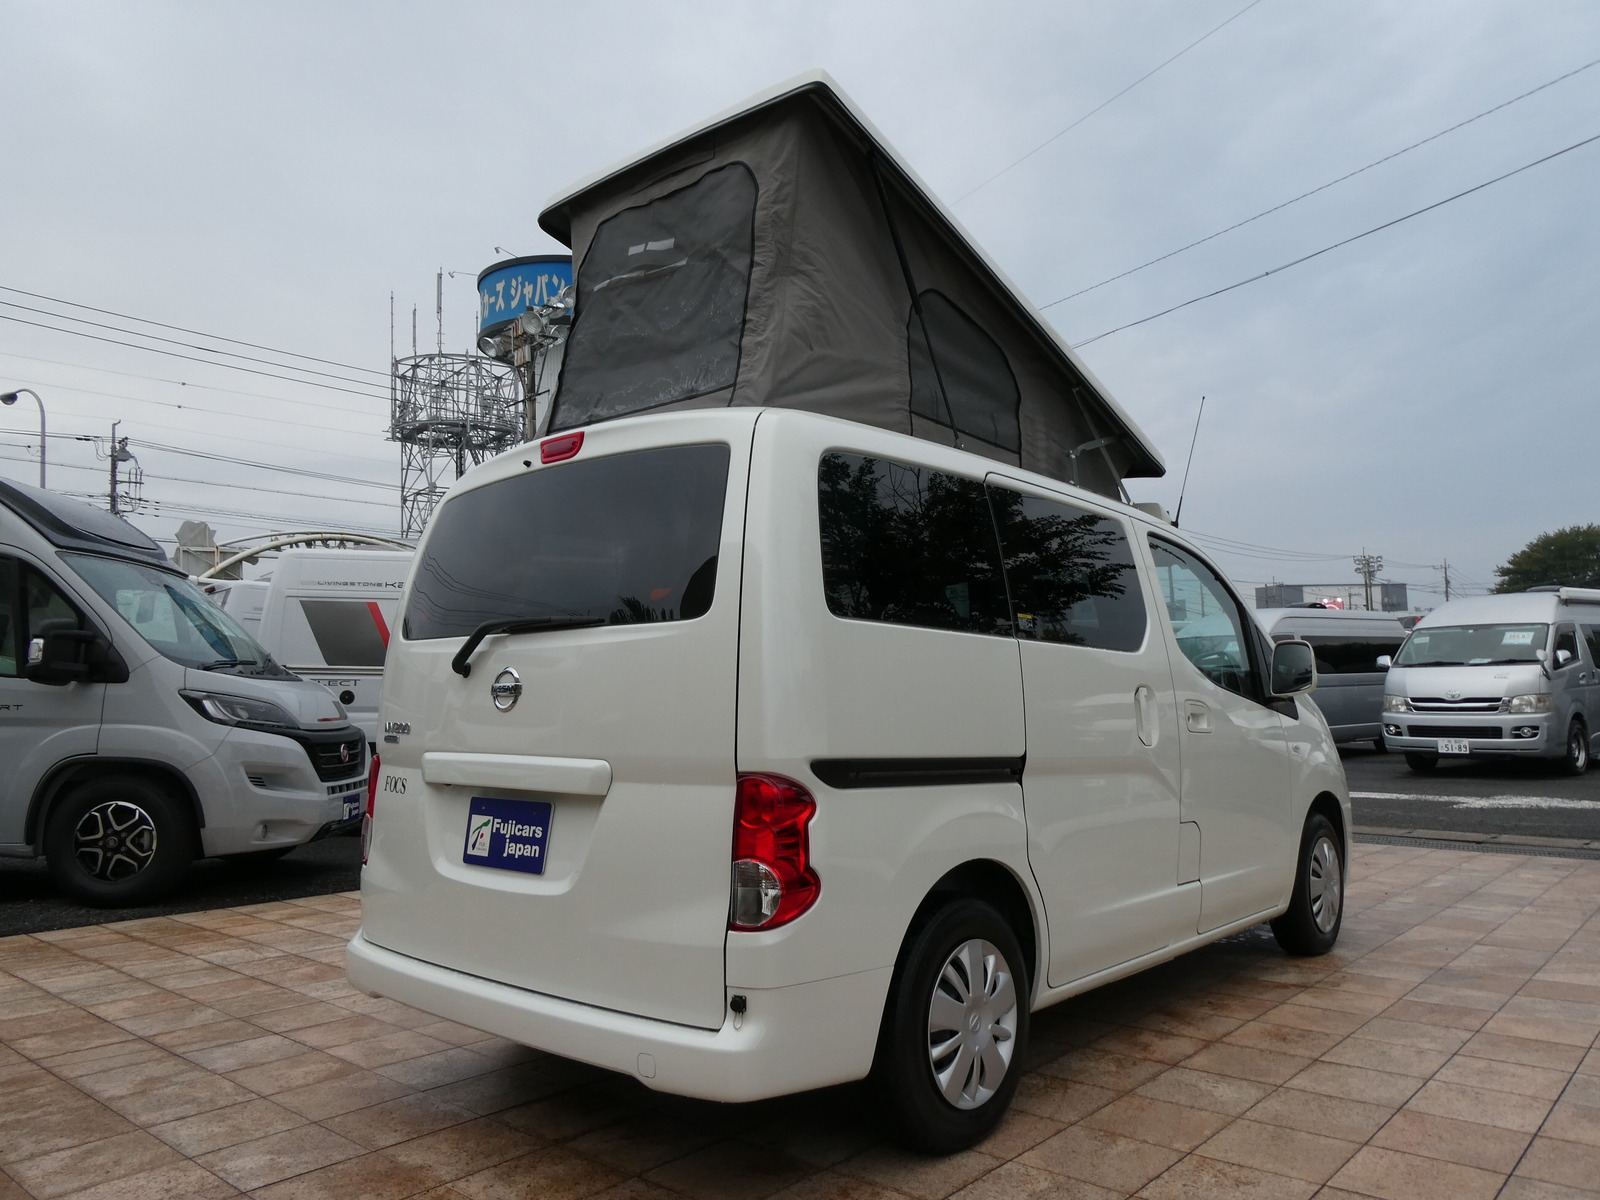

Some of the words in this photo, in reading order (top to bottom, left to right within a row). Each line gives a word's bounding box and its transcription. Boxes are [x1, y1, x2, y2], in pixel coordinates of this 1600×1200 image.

[317, 580, 383, 588] LIVINGSTONE
[1444, 743, 1468, 753] 51-89
[384, 775, 408, 795] FOCS
[493, 818, 543, 839] Fujicars
[503, 839, 540, 859] japan
